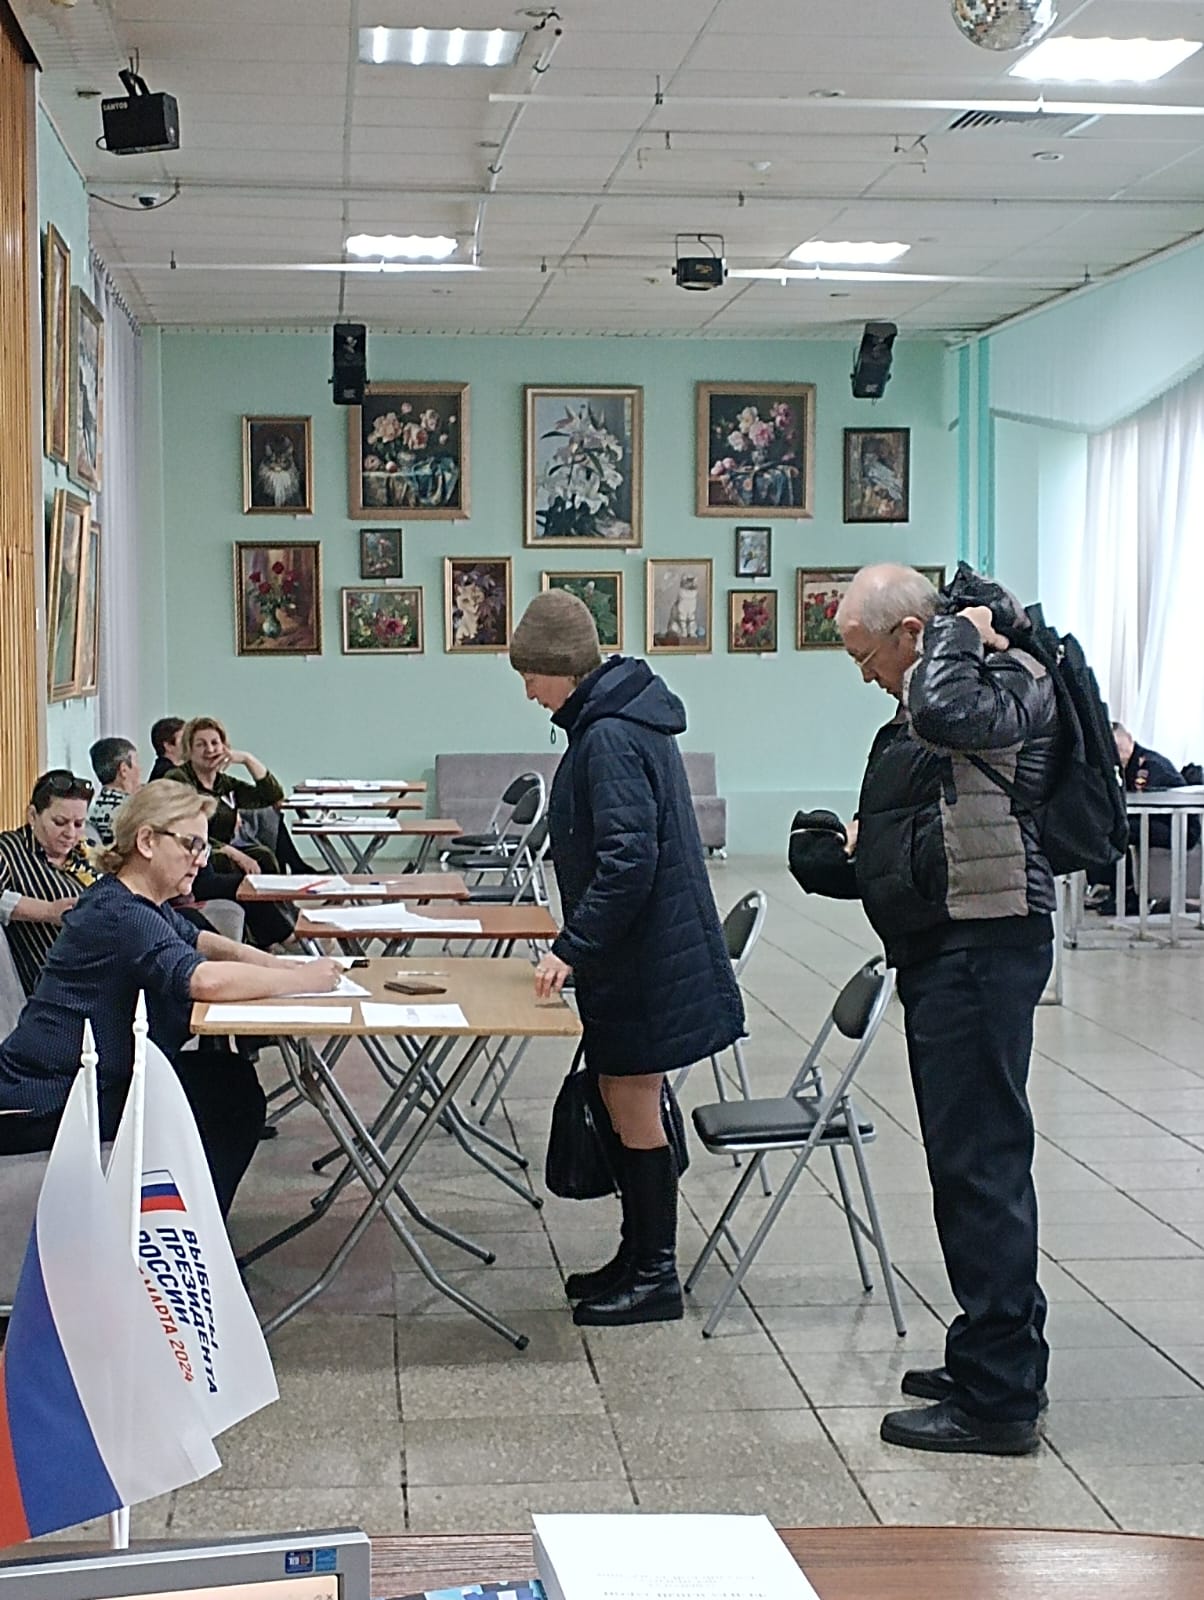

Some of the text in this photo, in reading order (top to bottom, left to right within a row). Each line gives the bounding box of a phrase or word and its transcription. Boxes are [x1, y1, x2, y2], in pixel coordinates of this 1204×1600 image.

[156, 1228, 218, 1392] ПРЕЗИДЕНТА
[182, 1229, 218, 1350] ВЫБОРЫ
[169, 1339, 194, 1381] 2024
